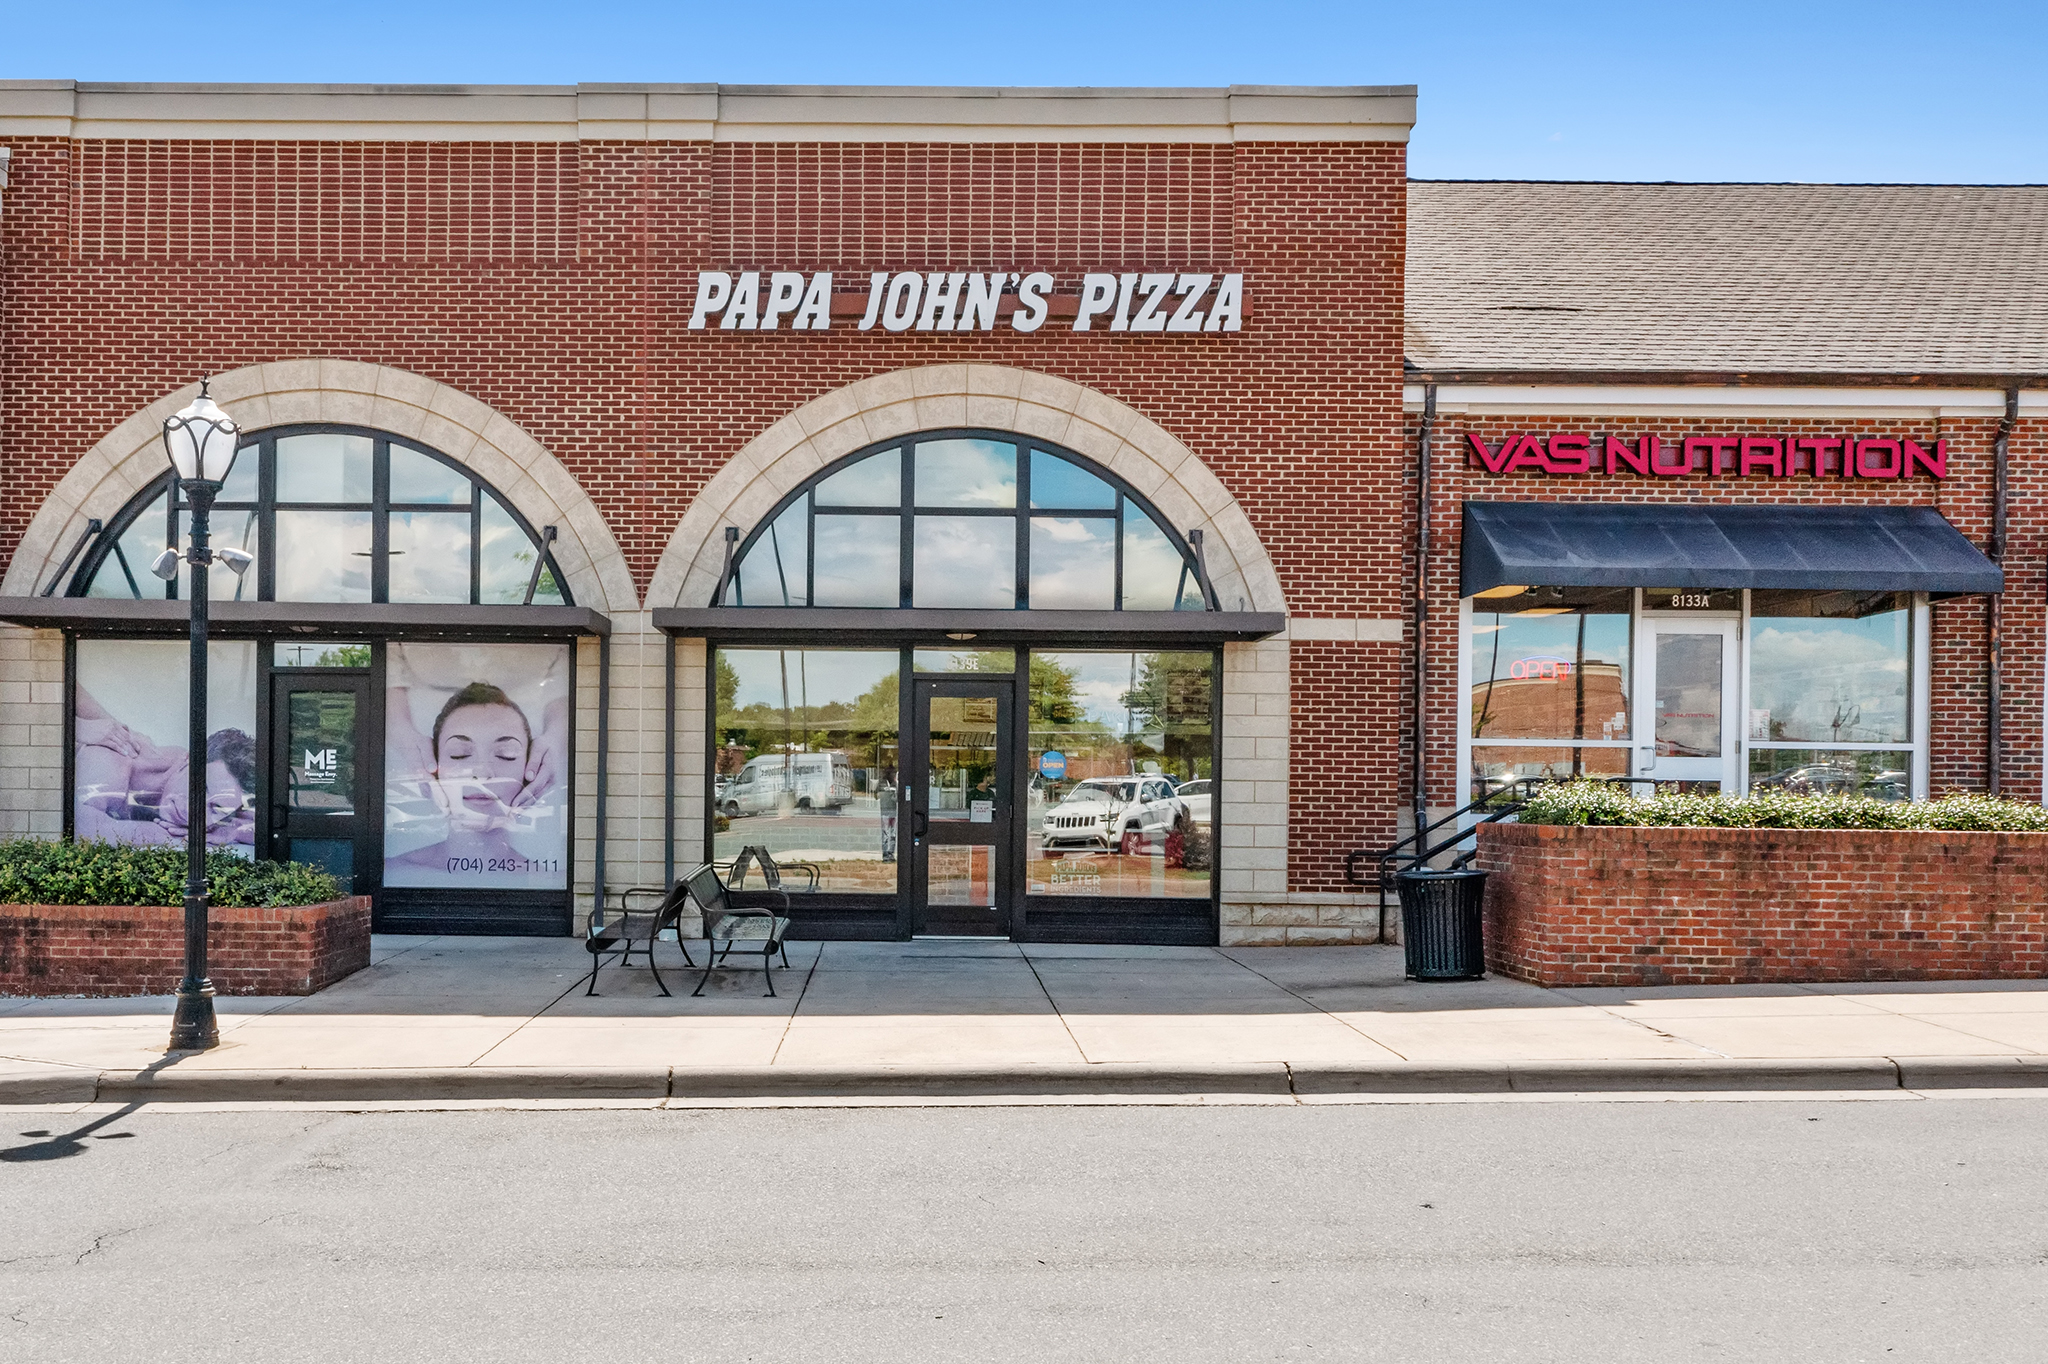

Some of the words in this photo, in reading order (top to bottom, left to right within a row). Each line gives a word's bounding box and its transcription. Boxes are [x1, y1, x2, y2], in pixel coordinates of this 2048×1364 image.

[687, 271, 833, 330] PAPA
[857, 271, 1054, 331] JOHN'S
[1072, 273, 1243, 332] PIZZA
[1466, 433, 1590, 474] VAS
[1604, 436, 1947, 480] NUTRITION
[1672, 594, 1709, 607] 8133A
[1510, 660, 1568, 681] OPEN
[304, 749, 337, 770] ME
[446, 857, 483, 874] (704)
[488, 858, 558, 872] 243-1111
[1051, 874, 1101, 885] BETTER
[1050, 885, 1102, 894] INGREDIENTS
